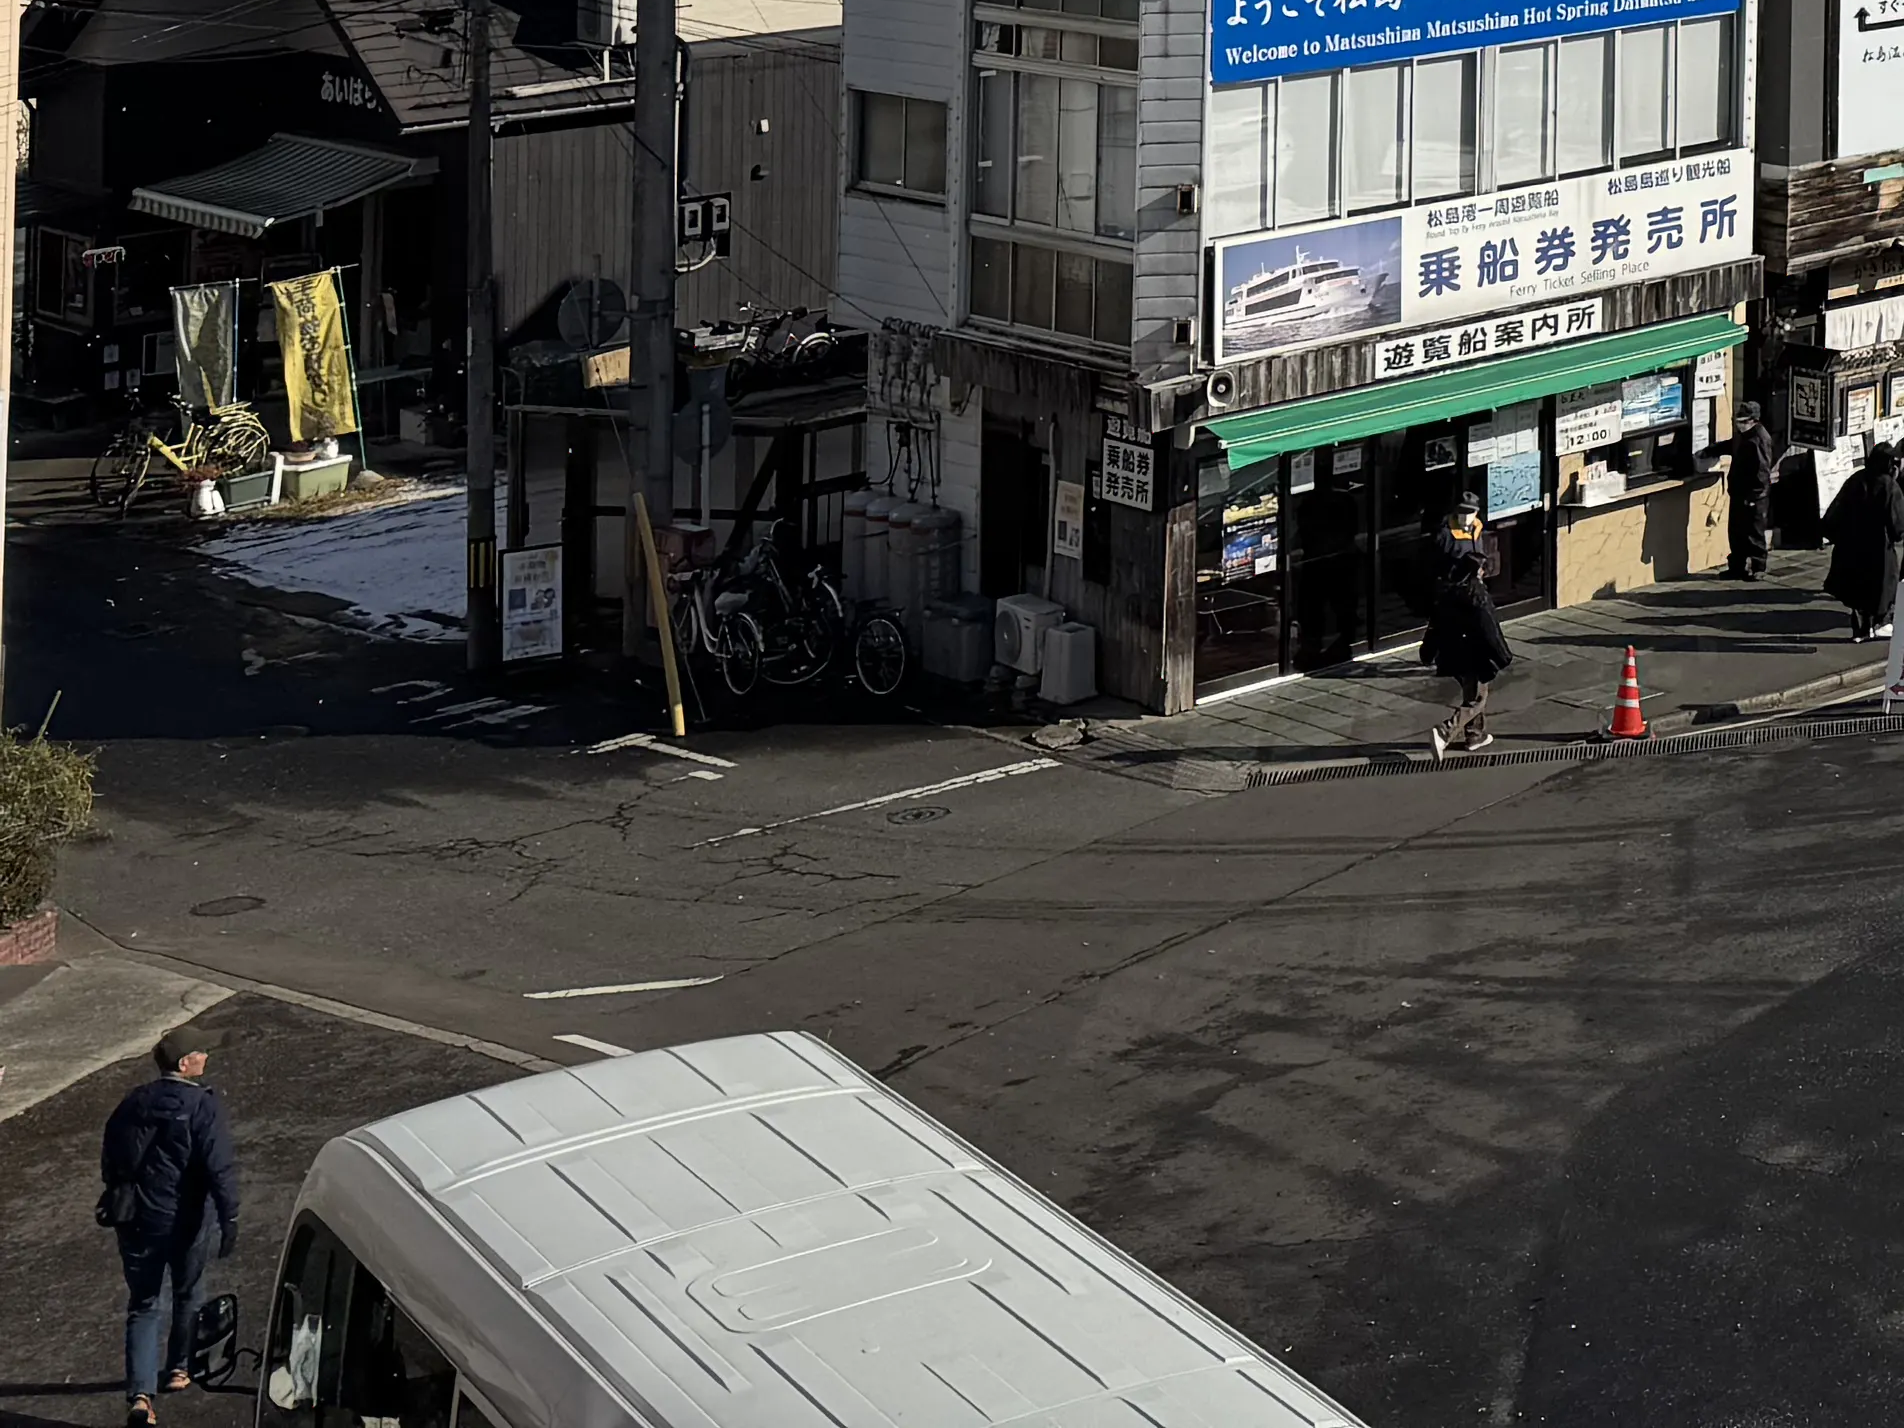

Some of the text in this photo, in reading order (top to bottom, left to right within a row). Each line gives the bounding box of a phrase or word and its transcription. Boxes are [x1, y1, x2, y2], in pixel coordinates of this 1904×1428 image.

[1225, 42, 1297, 67] Welcome
[1303, 39, 1320, 55] to
[1325, 26, 1421, 52] Matsushima
[1427, 9, 1519, 38] Matsushima
[1523, 6, 1552, 25] Hot
[321, 71, 382, 112] あいはら
[1419, 194, 1738, 298] 乗船券発売所
[1509, 282, 1538, 298] Ferry
[1543, 275, 1574, 291] Ticket
[1622, 261, 1650, 276] Place
[1382, 304, 1597, 373] 遊覧船案内所
[1107, 445, 1150, 476] 乗船券
[1105, 472, 1149, 504] 発売所
